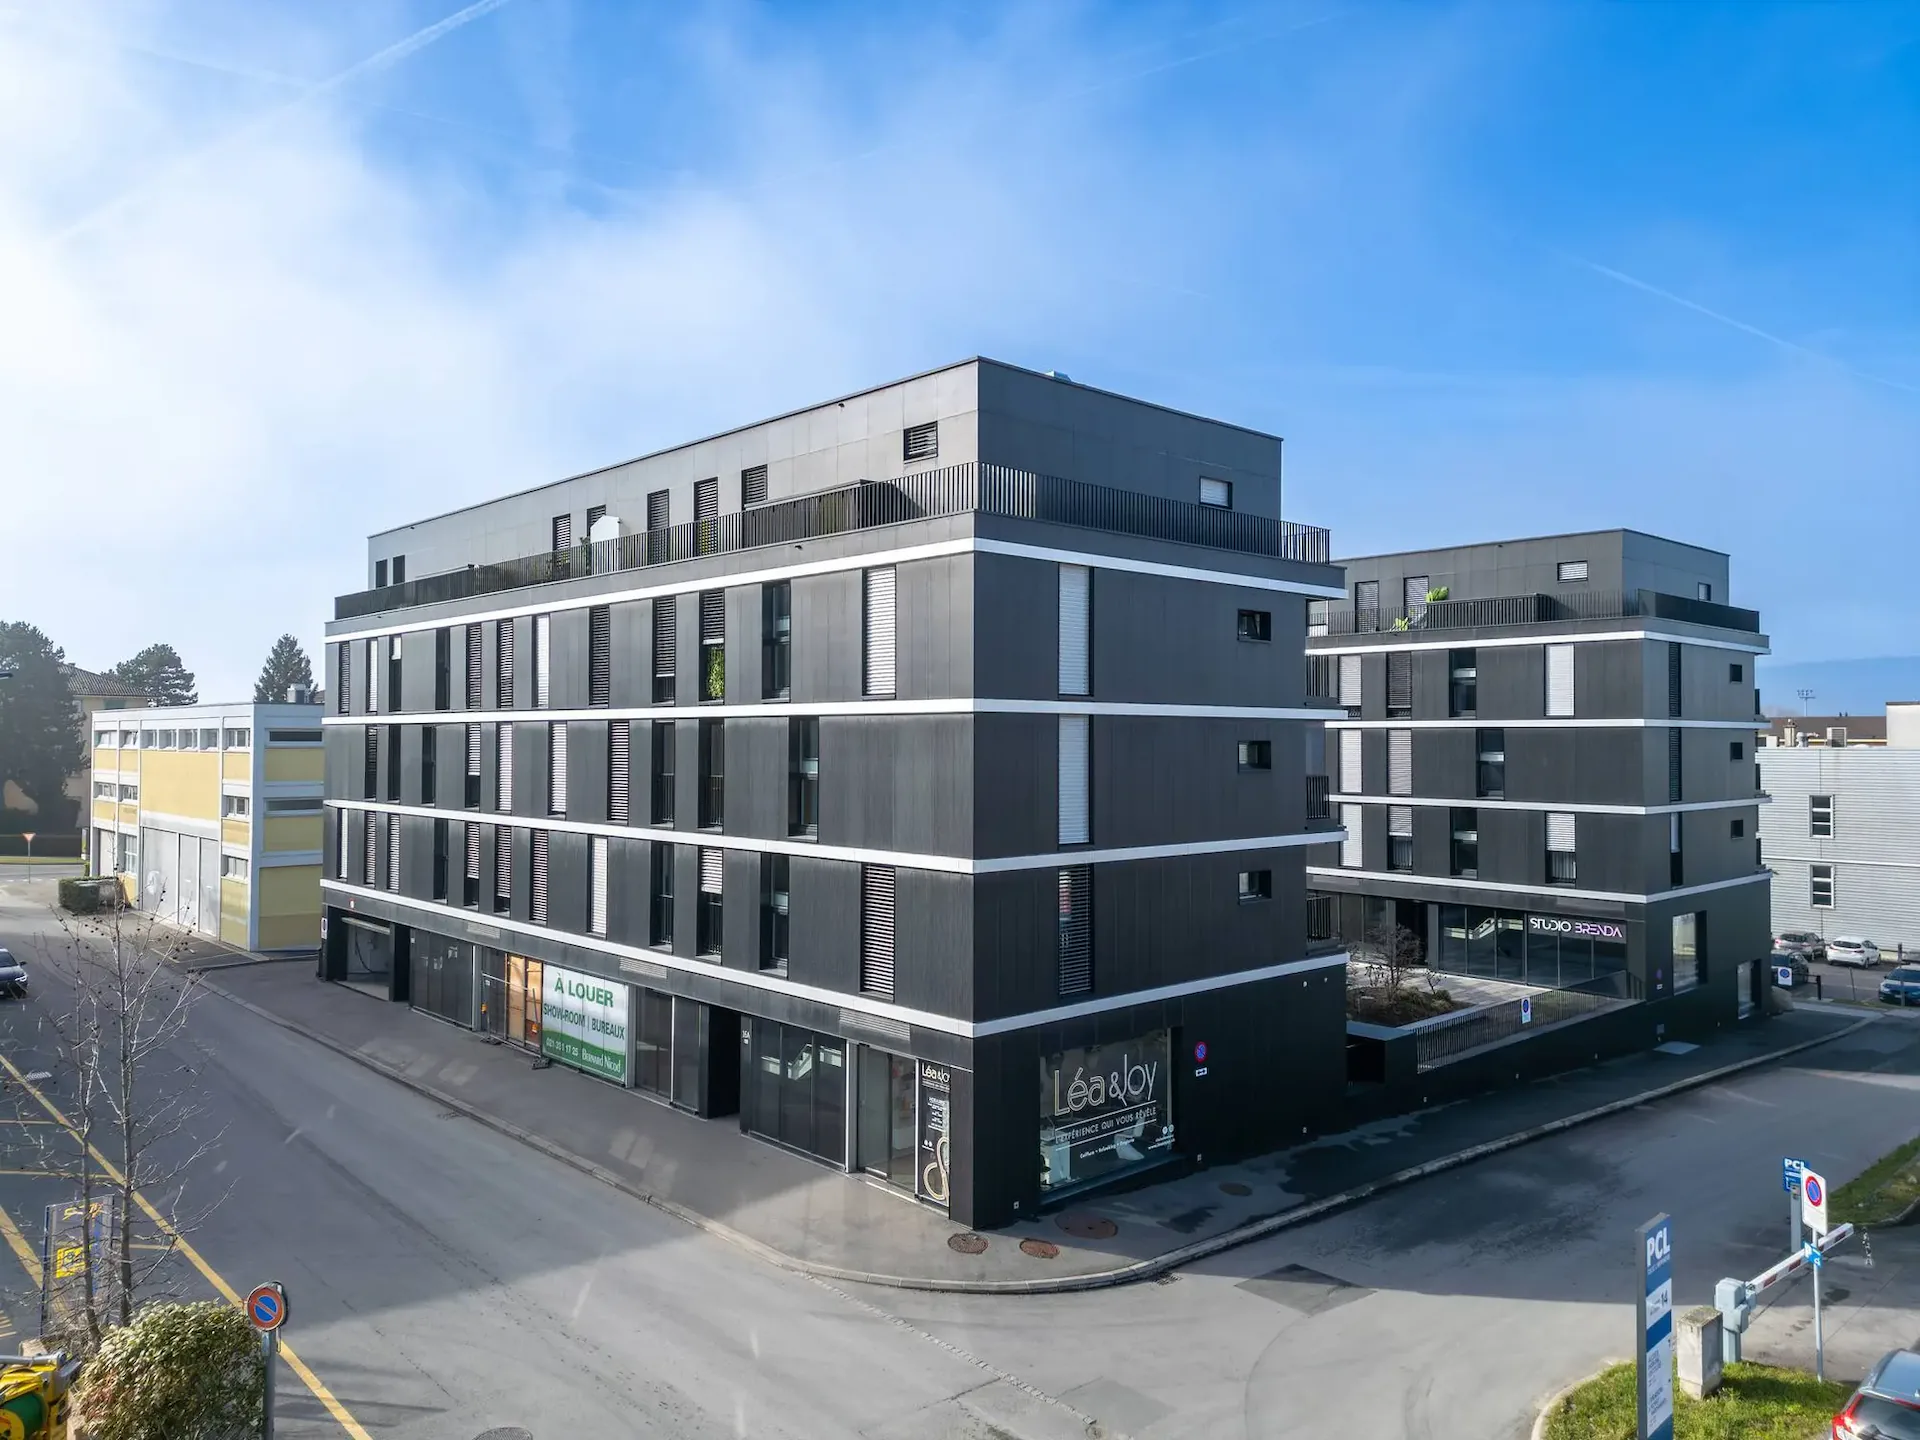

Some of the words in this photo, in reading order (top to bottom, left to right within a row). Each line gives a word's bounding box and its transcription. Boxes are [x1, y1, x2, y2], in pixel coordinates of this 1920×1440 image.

[1530, 917, 1572, 932] STUDIO
[1575, 922, 1622, 938] BRENDA
[554, 972, 565, 994] À
[568, 980, 614, 1008] LOUER
[543, 1003, 586, 1029] SHOW-ROOM
[591, 1018, 625, 1040] BUREAUX
[604, 1055, 621, 1073] Nicod
[1101, 1120, 1114, 1130] QUI
[1116, 1113, 1133, 1126] VOUS
[1646, 1227, 1671, 1267] PCL
